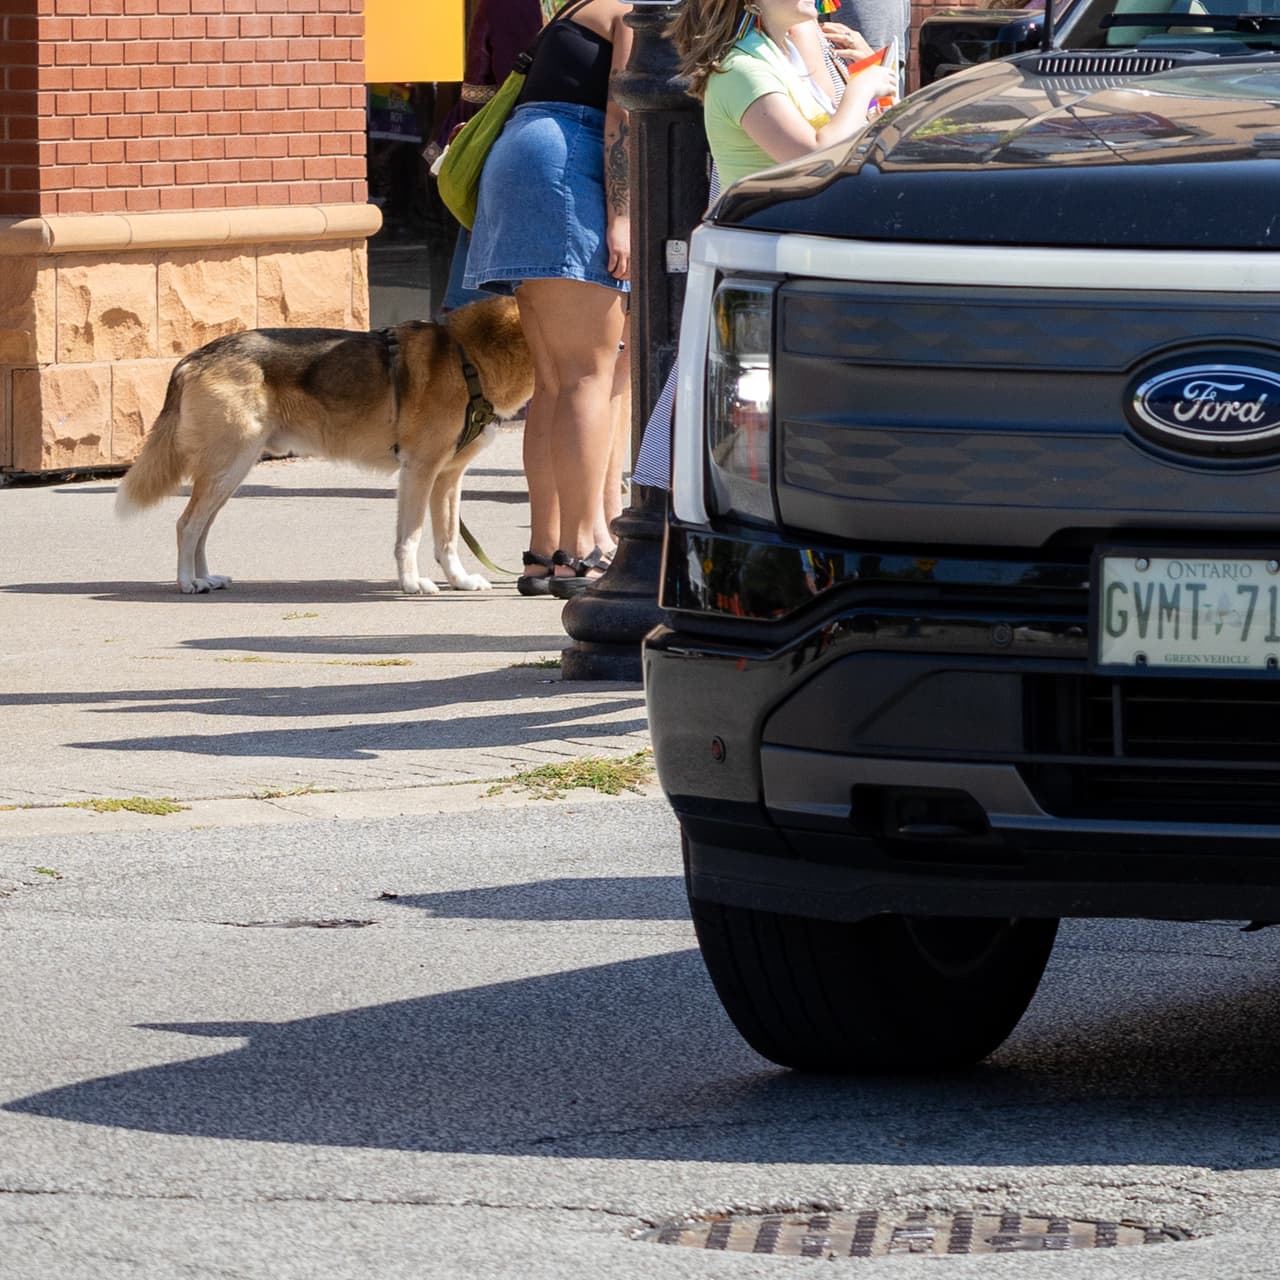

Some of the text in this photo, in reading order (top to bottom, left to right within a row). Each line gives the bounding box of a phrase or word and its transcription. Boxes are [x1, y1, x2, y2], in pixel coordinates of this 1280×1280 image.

[1173, 380, 1267, 422] Ford
[1167, 561, 1253, 581] ONTARIO
[1106, 581, 1207, 641] GVMT
[1164, 653, 1250, 665] GREEN VEHICLE
